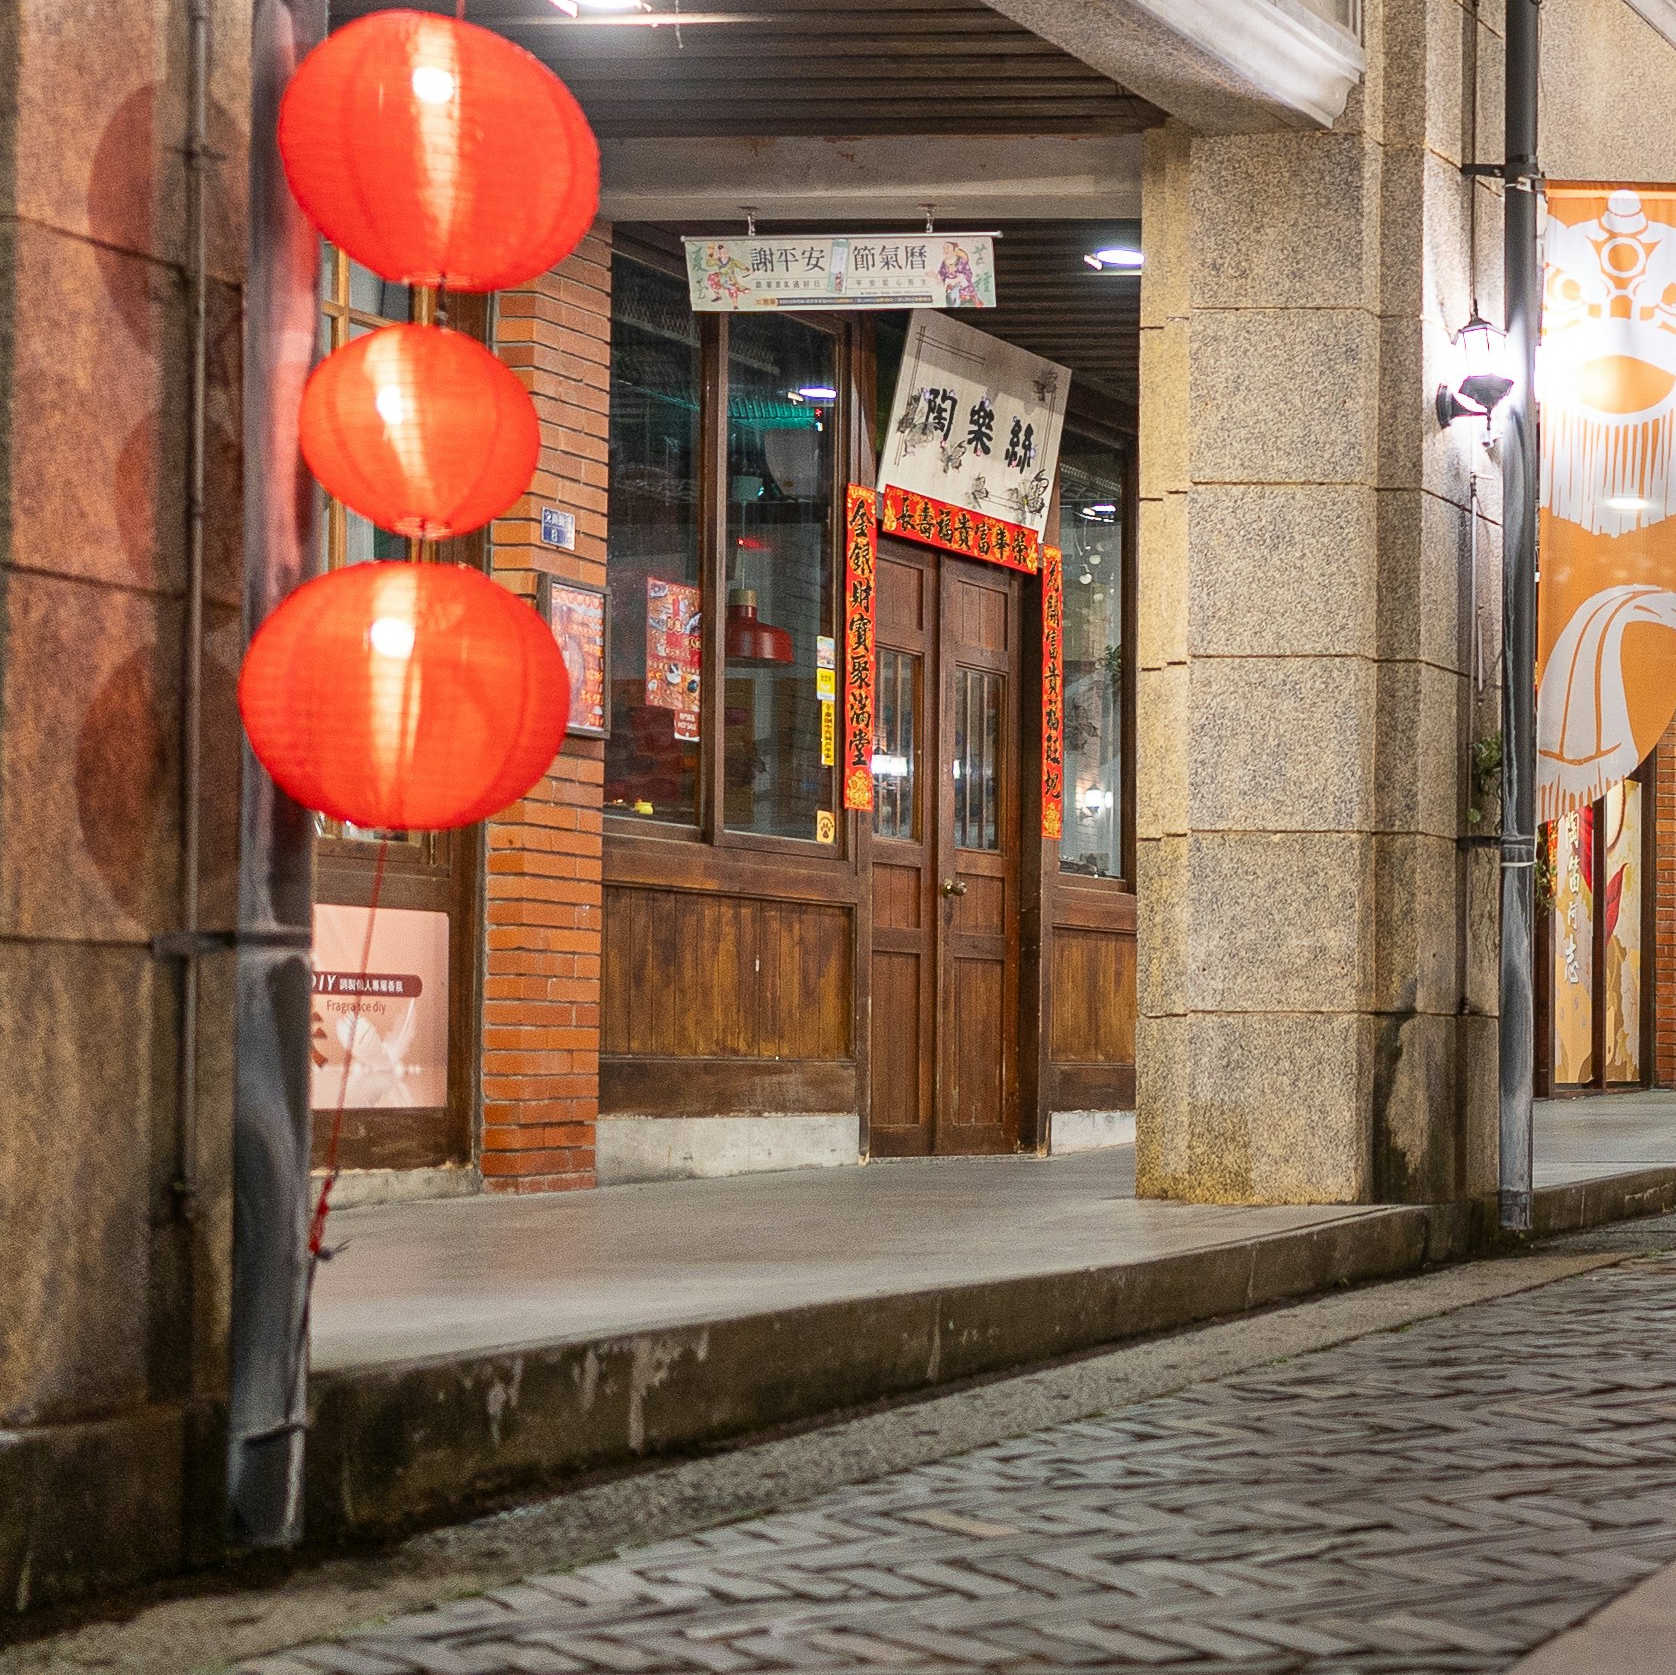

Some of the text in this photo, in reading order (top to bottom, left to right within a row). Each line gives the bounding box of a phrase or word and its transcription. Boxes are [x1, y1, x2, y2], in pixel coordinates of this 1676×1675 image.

[751, 244, 927, 273] 謝平安 節氣曆
[373, 1000, 387, 1015] diy
